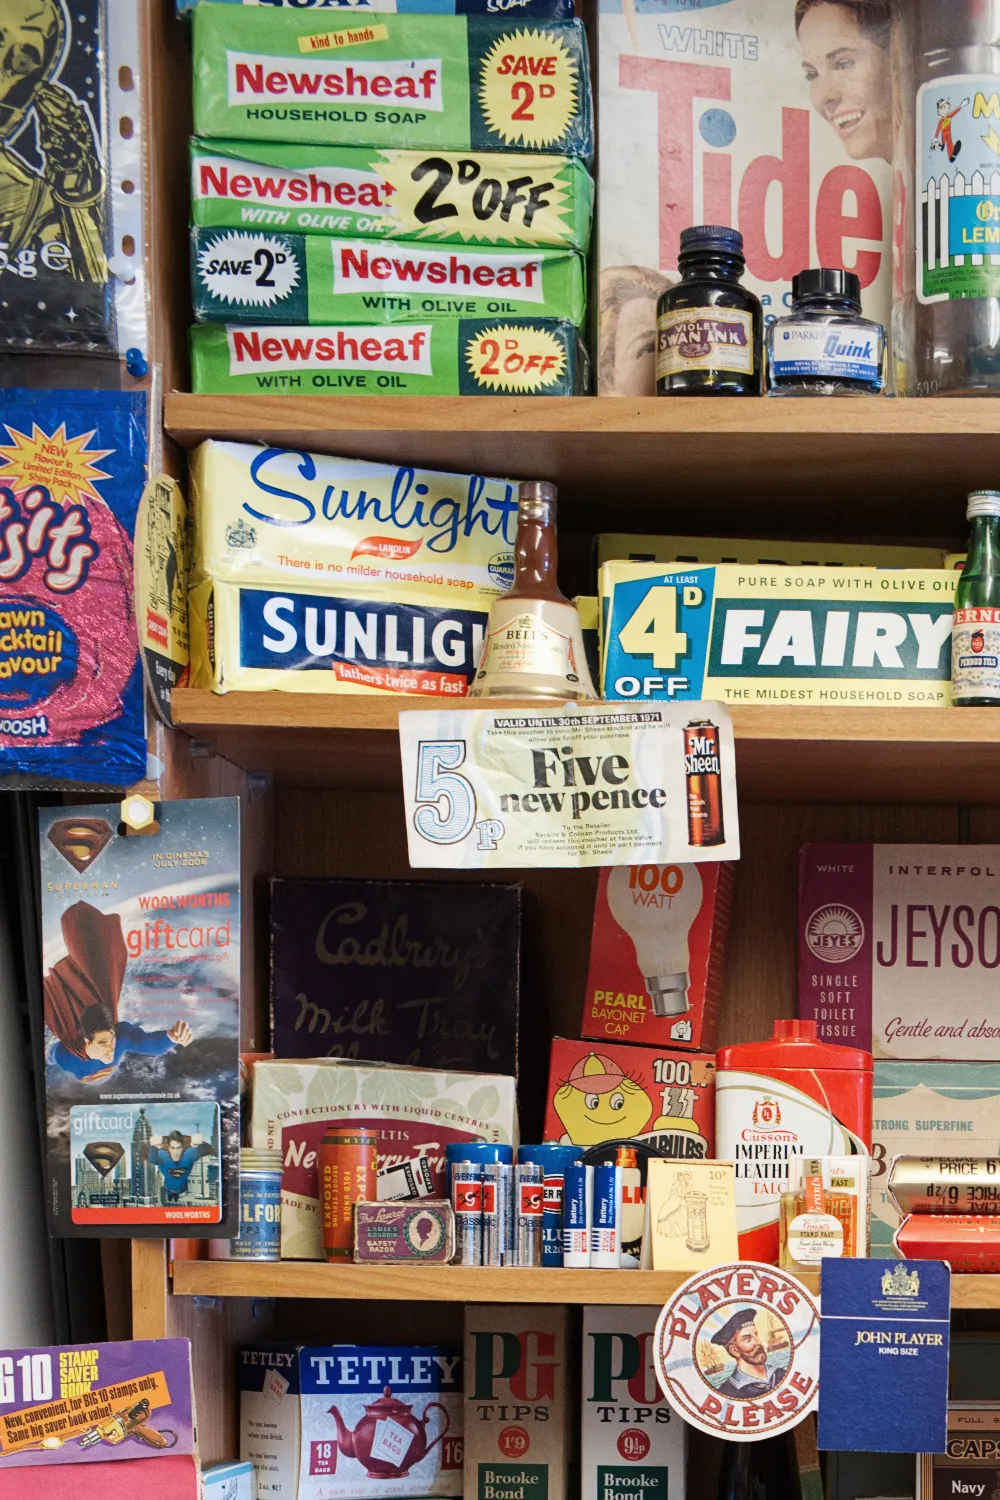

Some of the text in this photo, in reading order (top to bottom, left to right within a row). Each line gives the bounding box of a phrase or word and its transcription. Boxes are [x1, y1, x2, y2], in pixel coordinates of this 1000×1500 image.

[310, 29, 374, 49] kind to hands
[657, 24, 759, 61] WHITE
[497, 55, 557, 77] SAVE
[235, 64, 437, 98] Newsheaf
[246, 108, 427, 125] HOUSEHOLD SOAP
[619, 54, 883, 290] Tide
[473, 176, 554, 228] OFF
[340, 250, 538, 288] Newsheaf
[823, 335, 873, 359] Quink
[23, 462, 82, 480] Limited Edition
[242, 448, 520, 553] Sunlight
[277, 555, 474, 590] There is no milder household soap
[721, 610, 954, 669] FAIRY
[340, 668, 463, 694] lathers twice as fast
[614, 677, 688, 696] OFF
[725, 689, 944, 701] THE MILDEST HOUSEHOLD SOAP
[582, 713, 660, 725] SEPTEMBER 1971
[531, 746, 629, 788] Five
[499, 786, 667, 820] new pence
[138, 892, 231, 911] WOOLWORTHS
[632, 892, 674, 909] WATT
[127, 918, 231, 960] giftcard
[812, 975, 857, 987] SINGLE
[593, 991, 647, 1009] PEARL
[820, 991, 851, 1003] SOFT
[591, 1008, 646, 1024] BAYONET
[605, 1023, 630, 1035] CAP
[885, 1017, 932, 1043] Gentle
[935, 1022, 964, 1037] and
[276, 1103, 491, 1131] CONFECTIONERY WITH LIQUID CENTRES
[669, 1273, 800, 1341] PLAYER'S
[855, 1331, 943, 1347] JOHN PLAYER
[60, 1350, 99, 1368] STAMP
[879, 1347, 918, 1356] KING SIZE
[60, 1365, 99, 1383] SAVER
[310, 1355, 461, 1386] TETLEY
[700, 1372, 813, 1428] PLEASE
[951, 1480, 985, 1496] Navy
